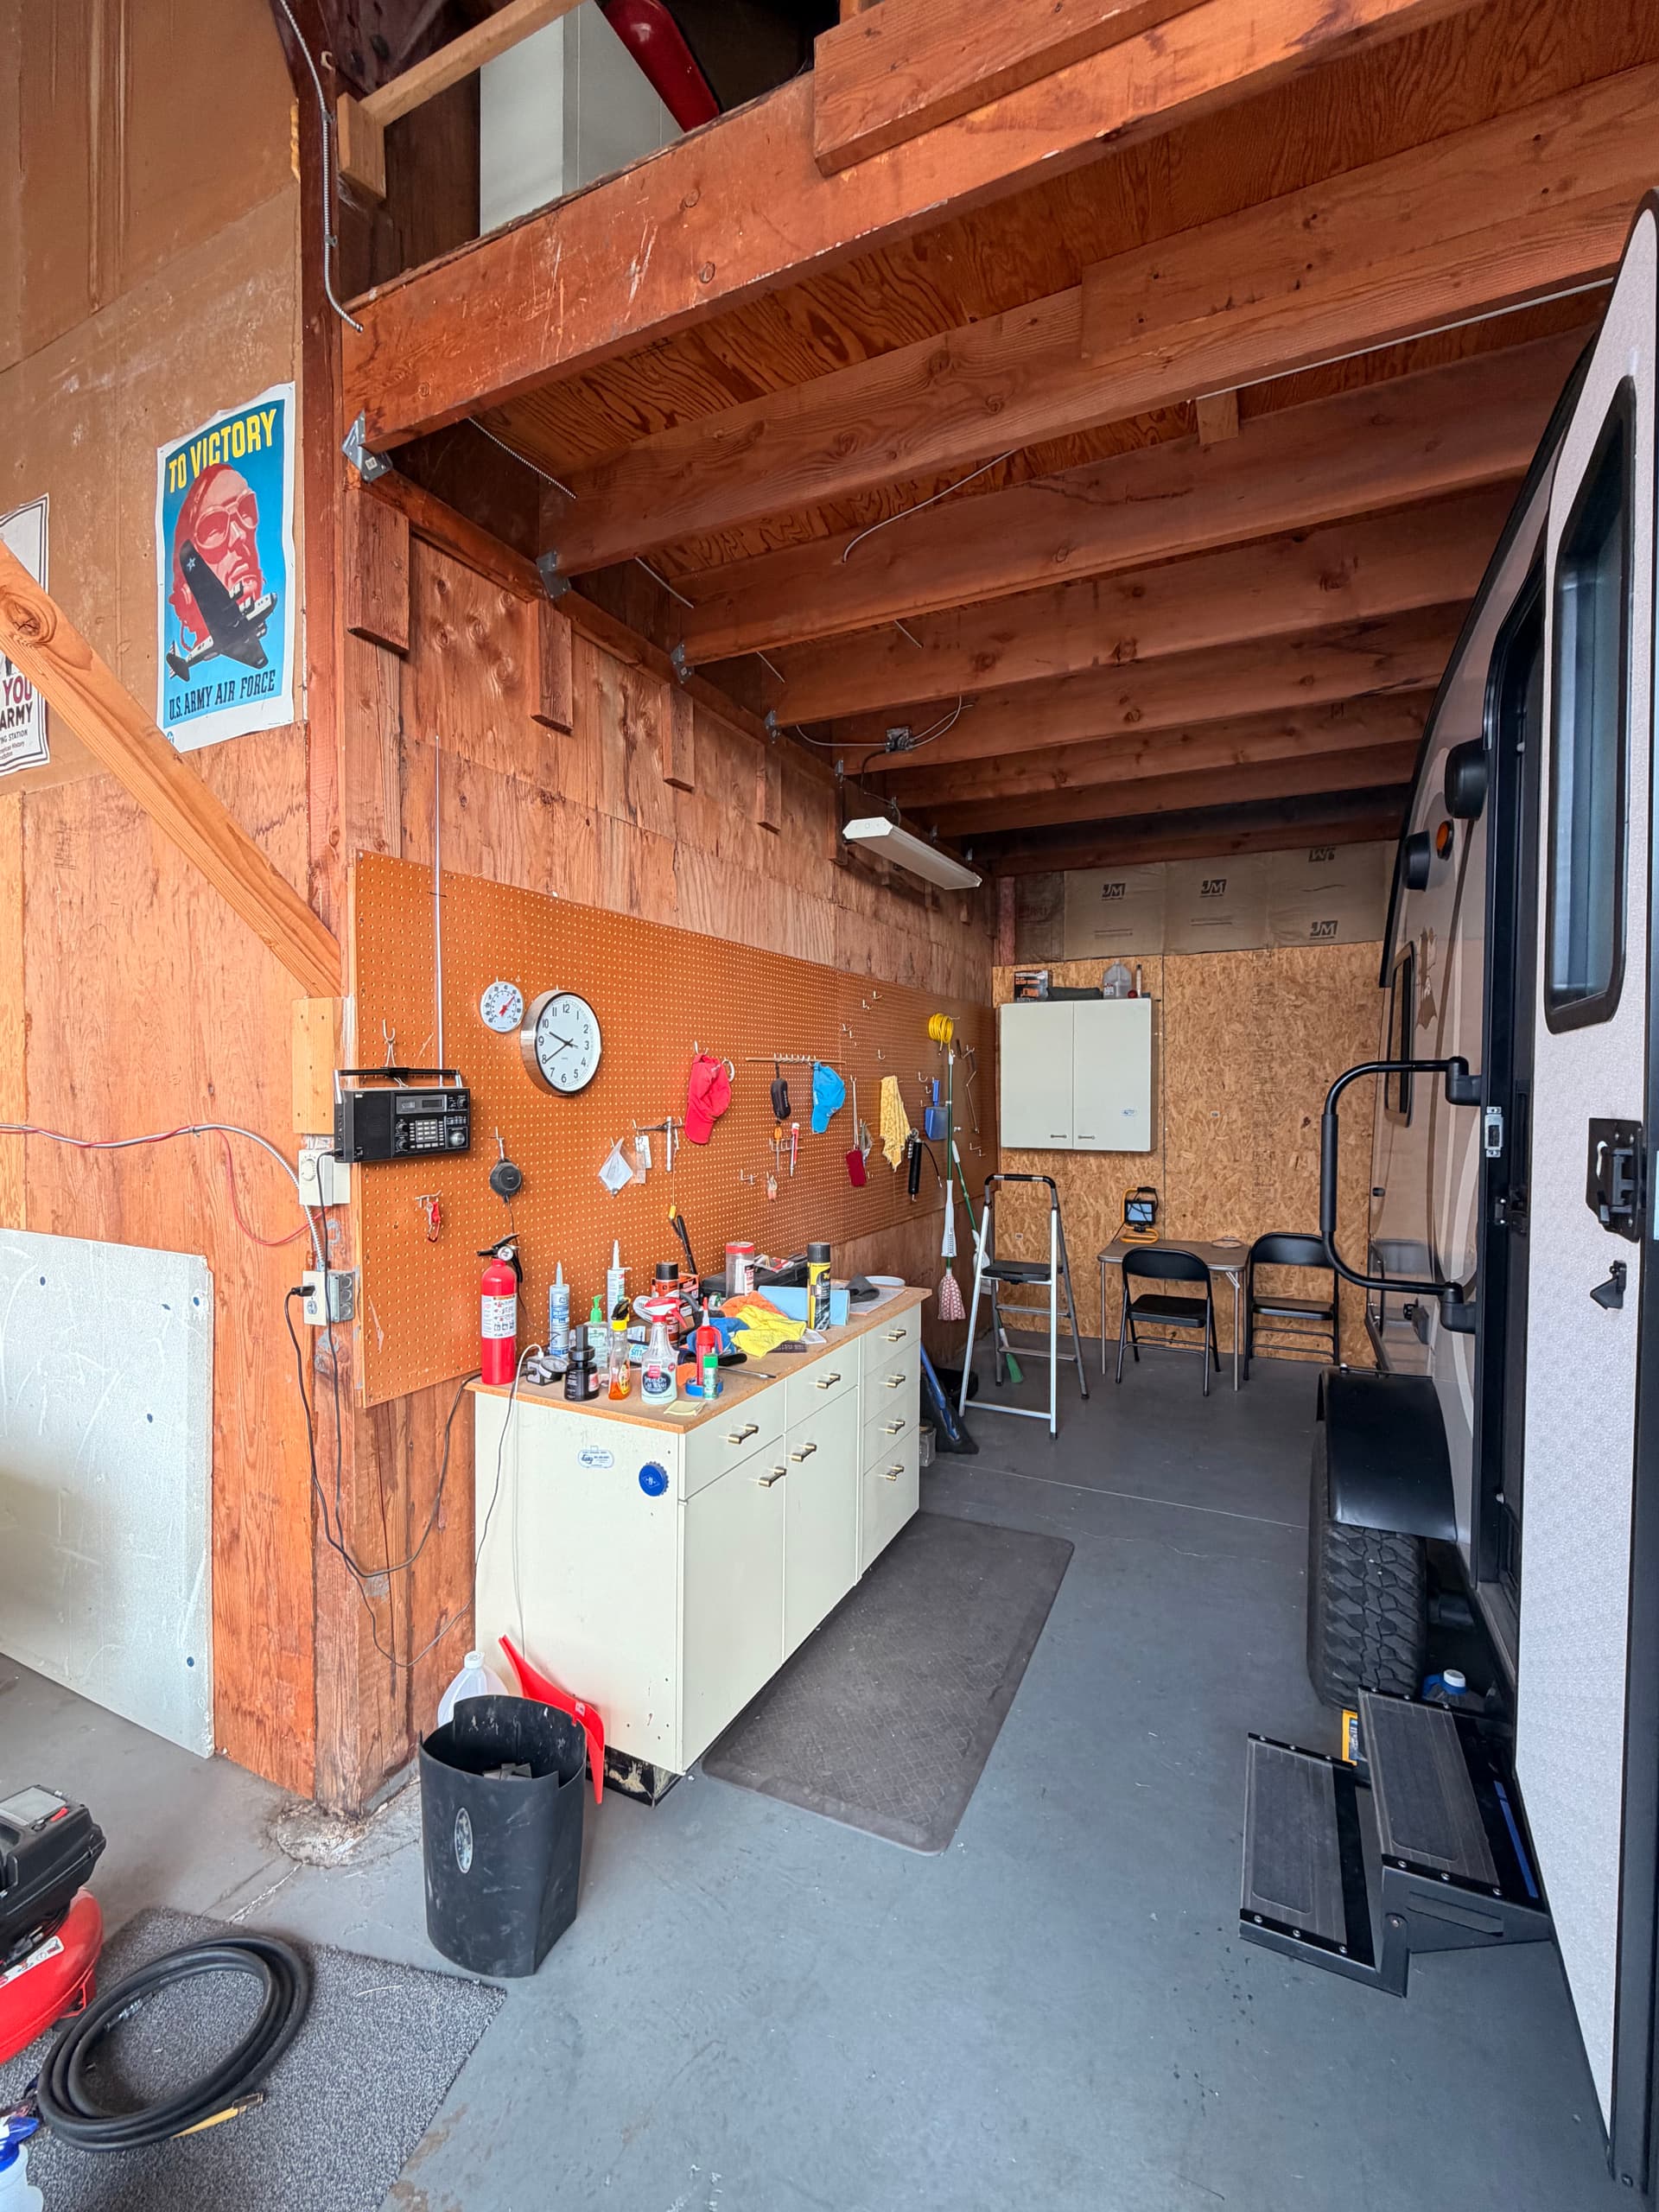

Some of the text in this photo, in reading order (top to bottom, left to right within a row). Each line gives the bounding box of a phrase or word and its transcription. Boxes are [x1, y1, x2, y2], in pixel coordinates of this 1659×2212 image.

[169, 408, 277, 493] TO VICTORY
[3, 675, 33, 707] YOU
[168, 669, 276, 721] U.S. ARMY AIR FORCE
[8, 728, 28, 741] STATION
[1102, 883, 1126, 898] JM
[1201, 879, 1227, 894] JM
[1310, 920, 1338, 937] JM
[551, 1007, 557, 1017] 11
[563, 1003, 570, 1014] 12
[576, 1010, 580, 1020] 1
[542, 1018, 550, 1028] 10
[583, 1024, 589, 1034] 2
[537, 1036, 544, 1046] 9
[584, 1040, 589, 1051] 3
[541, 1053, 547, 1065] 8
[581, 1057, 587, 1068] 4
[550, 1067, 556, 1078] 7
[573, 1069, 579, 1079] 5
[561, 1073, 567, 1084] 6
